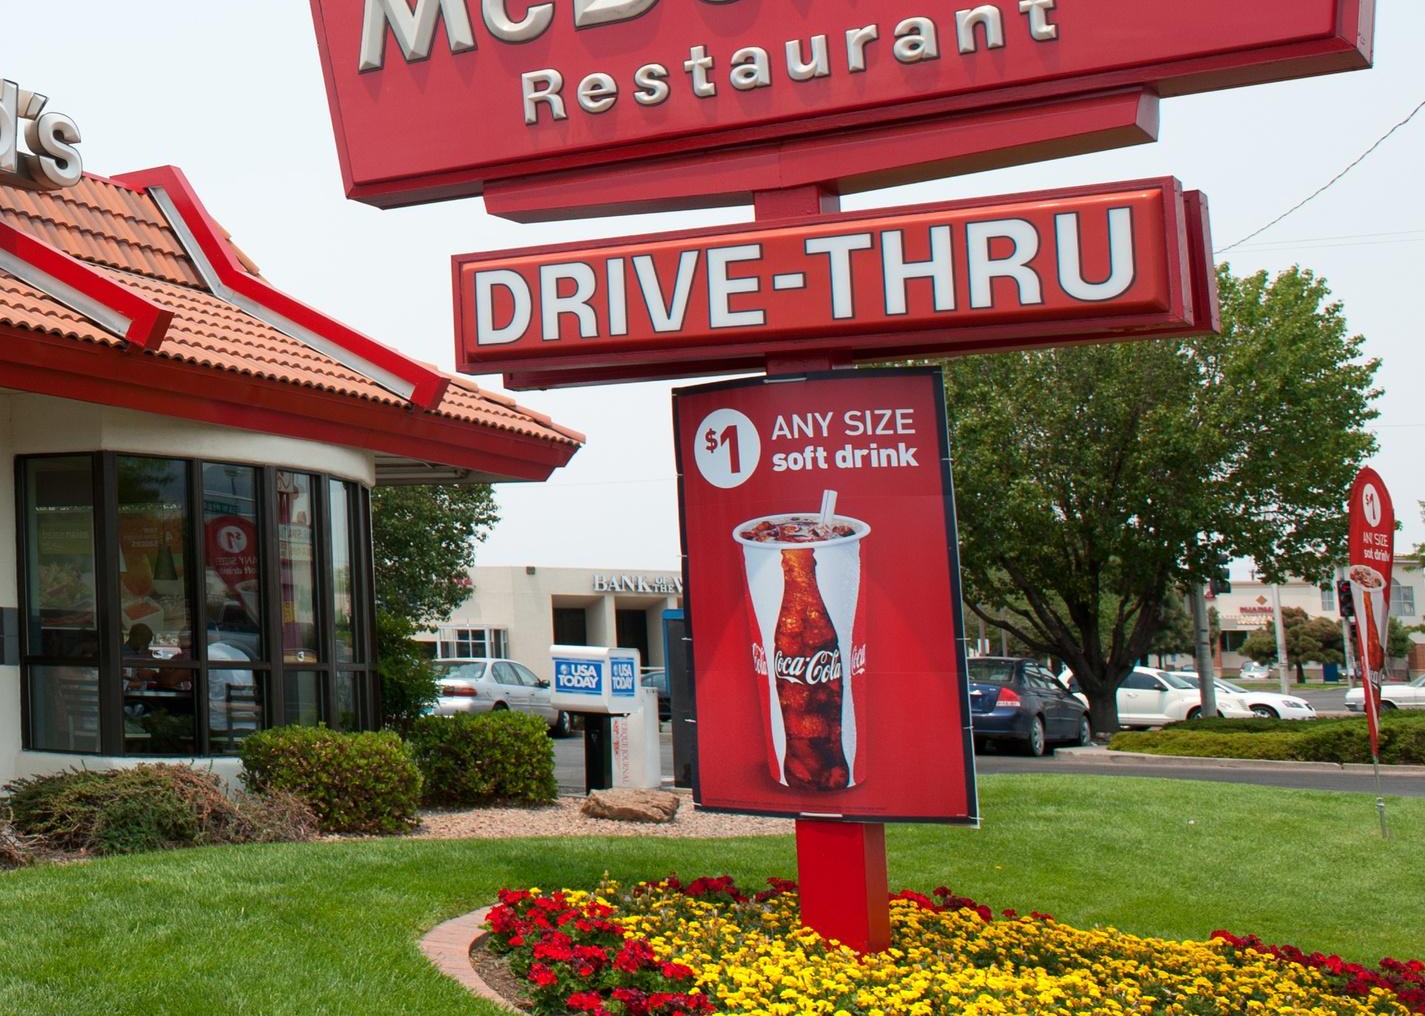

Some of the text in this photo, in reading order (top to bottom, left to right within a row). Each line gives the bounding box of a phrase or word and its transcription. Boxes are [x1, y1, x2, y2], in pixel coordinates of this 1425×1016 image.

[474, 206, 1138, 347] DRIVE-THRU
[771, 408, 916, 441] ANY SIZE
[704, 423, 742, 474] $1
[772, 442, 919, 472] soft drink
[592, 574, 651, 592] BANK
[652, 584, 673, 593] THE
[558, 675, 599, 688] TODAY
[571, 664, 597, 676] USA
[618, 664, 633, 676] USA
[775, 650, 841, 685] Coca-Cola
